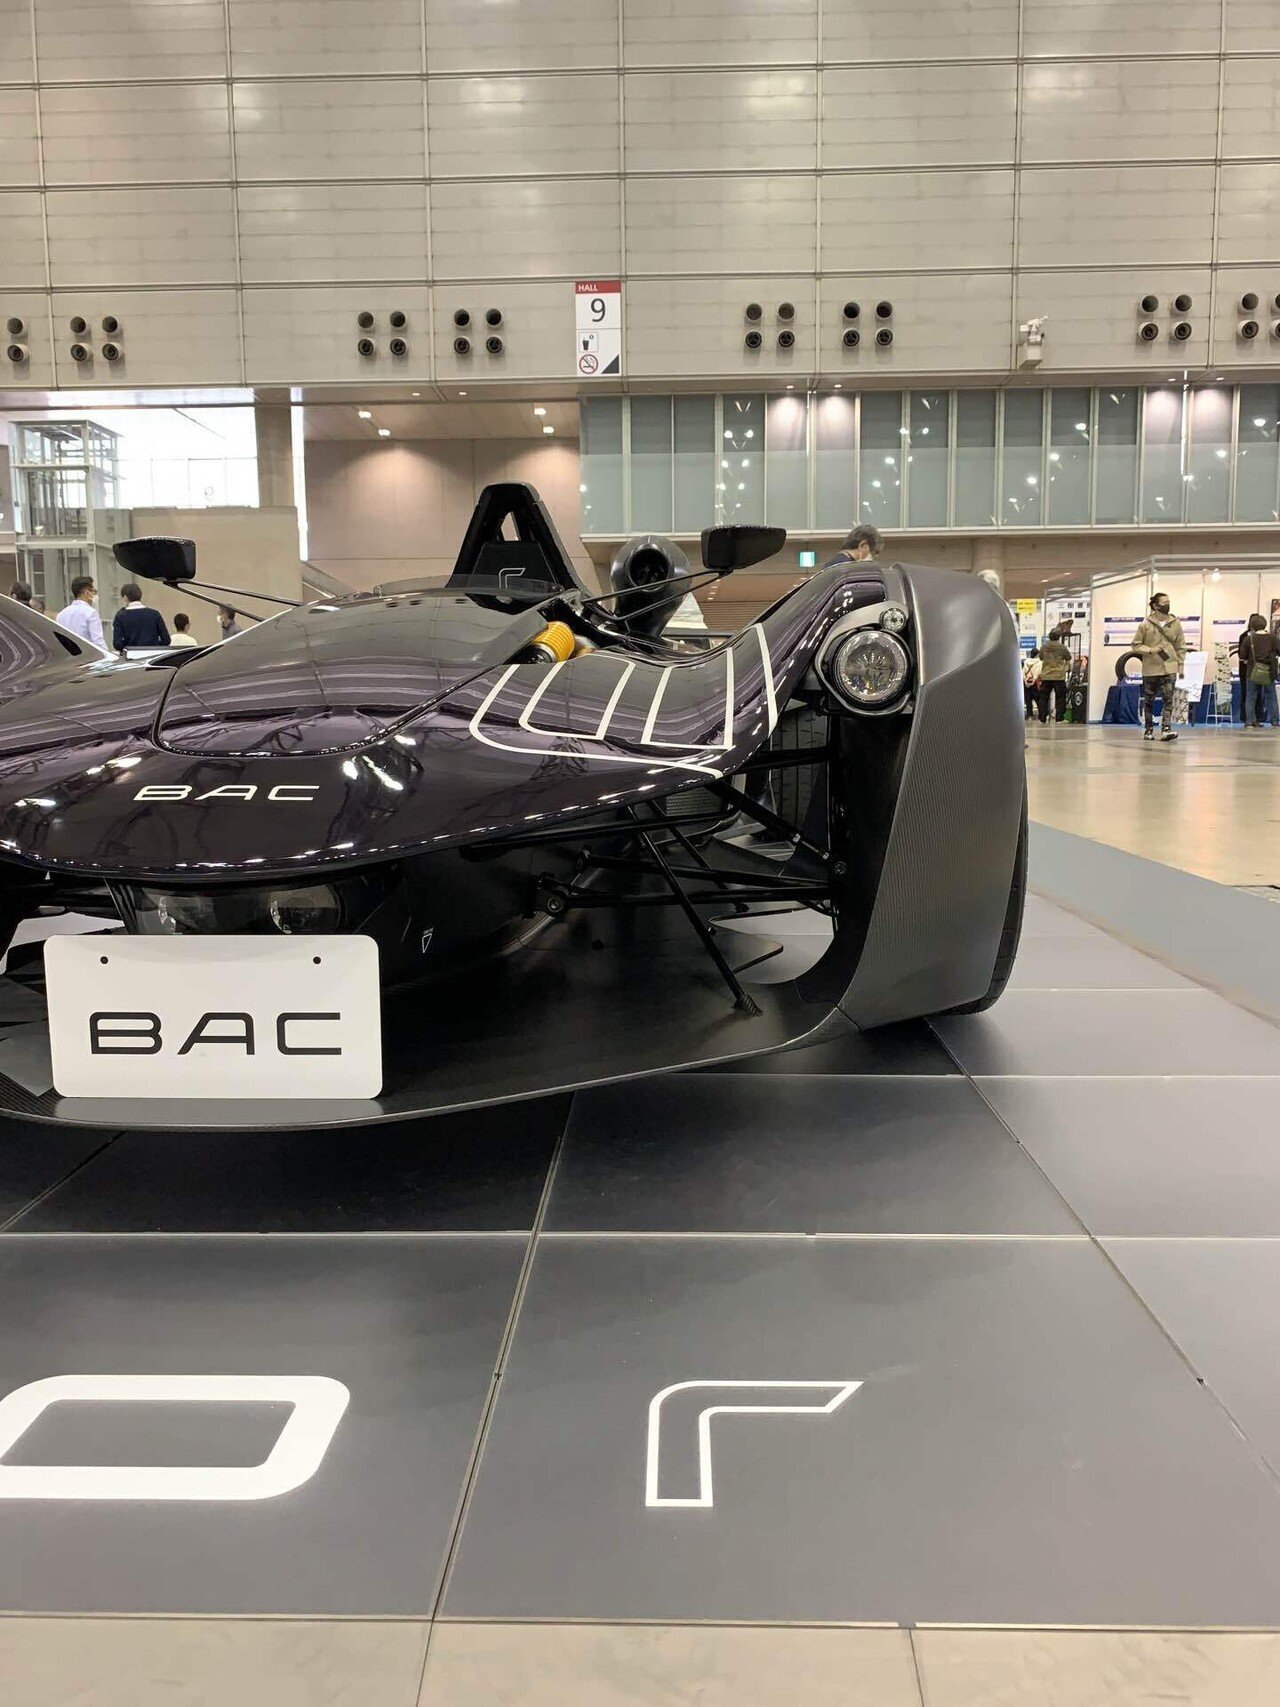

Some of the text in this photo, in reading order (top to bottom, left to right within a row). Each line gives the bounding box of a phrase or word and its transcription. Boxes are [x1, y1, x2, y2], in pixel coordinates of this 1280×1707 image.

[578, 284, 598, 292] HALL
[590, 298, 606, 322] 9
[133, 785, 320, 802] BAC
[89, 1012, 342, 1056] BAC
